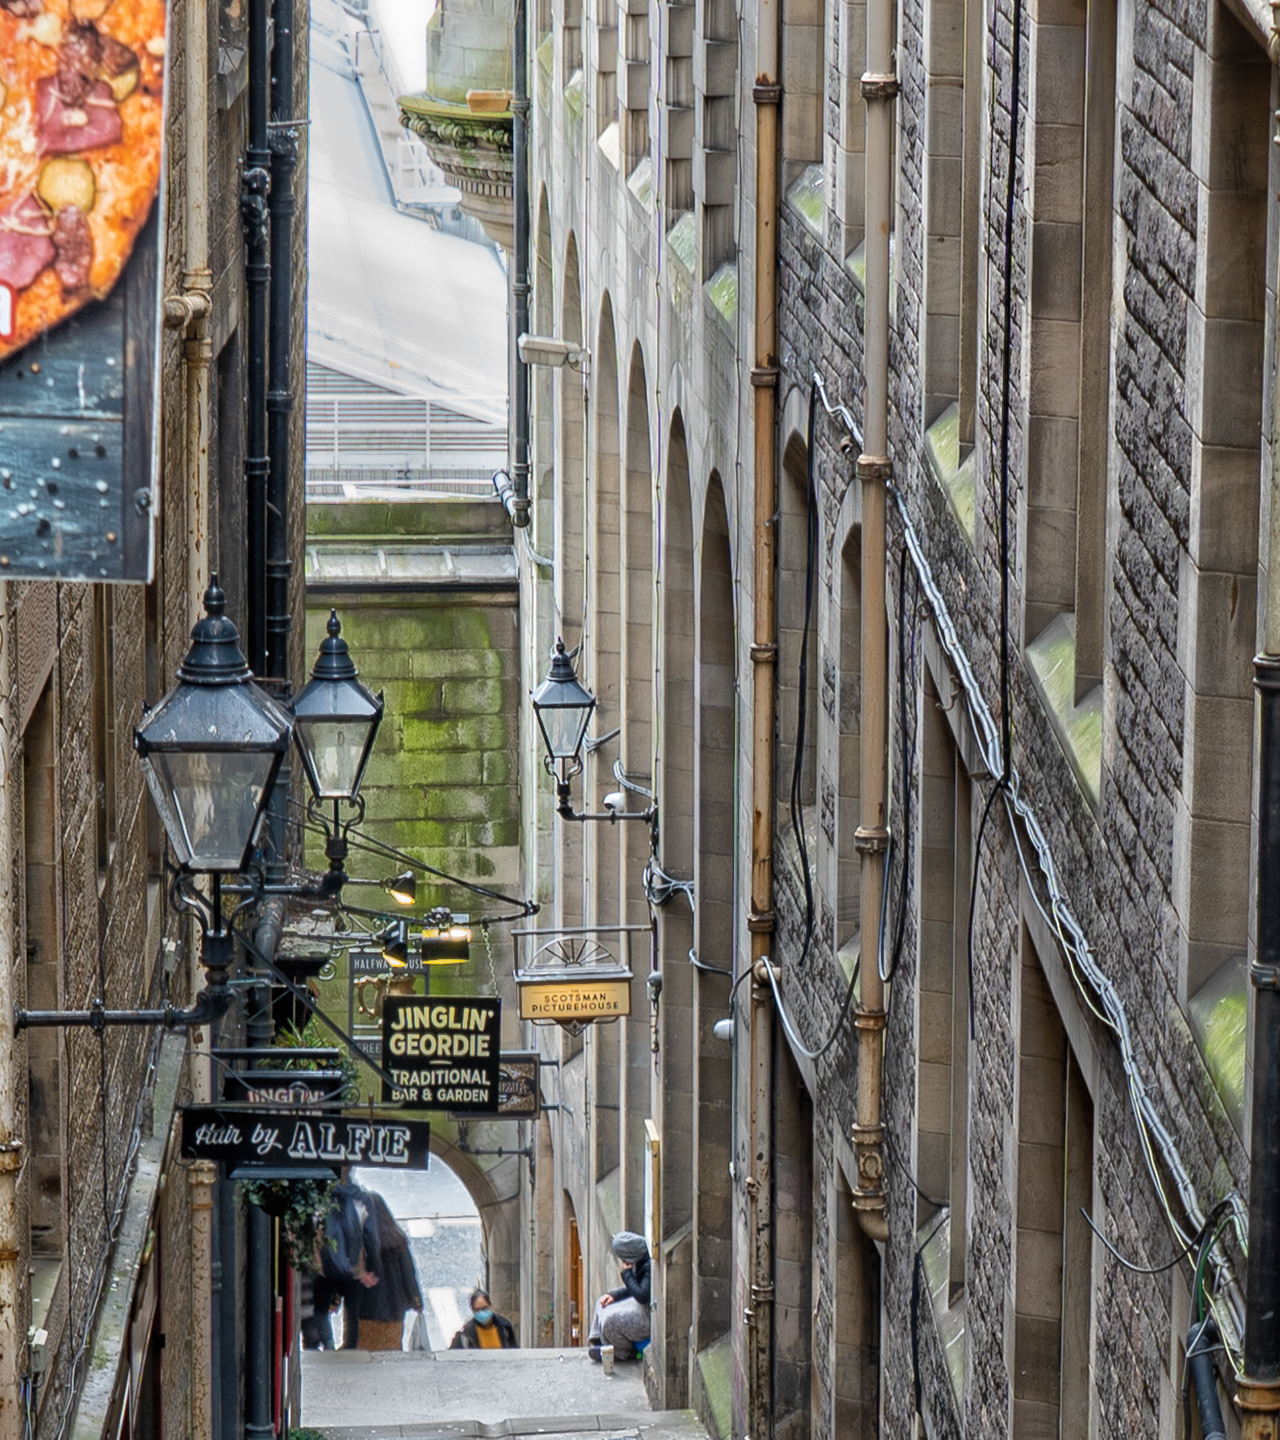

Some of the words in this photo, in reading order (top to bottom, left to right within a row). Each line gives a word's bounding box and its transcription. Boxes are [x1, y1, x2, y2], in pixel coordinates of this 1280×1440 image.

[354, 958, 389, 970] HALFWA
[544, 992, 607, 1003] SCOTSMAN
[531, 1001, 619, 1013] PICTUREHOUSE
[390, 1006, 494, 1032] JINGLIN'
[389, 1033, 490, 1057] GEORDIE
[390, 1068, 491, 1087] TRADITIONAL
[391, 1087, 418, 1101] BAR
[422, 1087, 432, 1101] &
[436, 1088, 489, 1103] GARDEN
[195, 1122, 243, 1146] Hair
[251, 1122, 283, 1156] by
[287, 1120, 412, 1164] ALFIE
